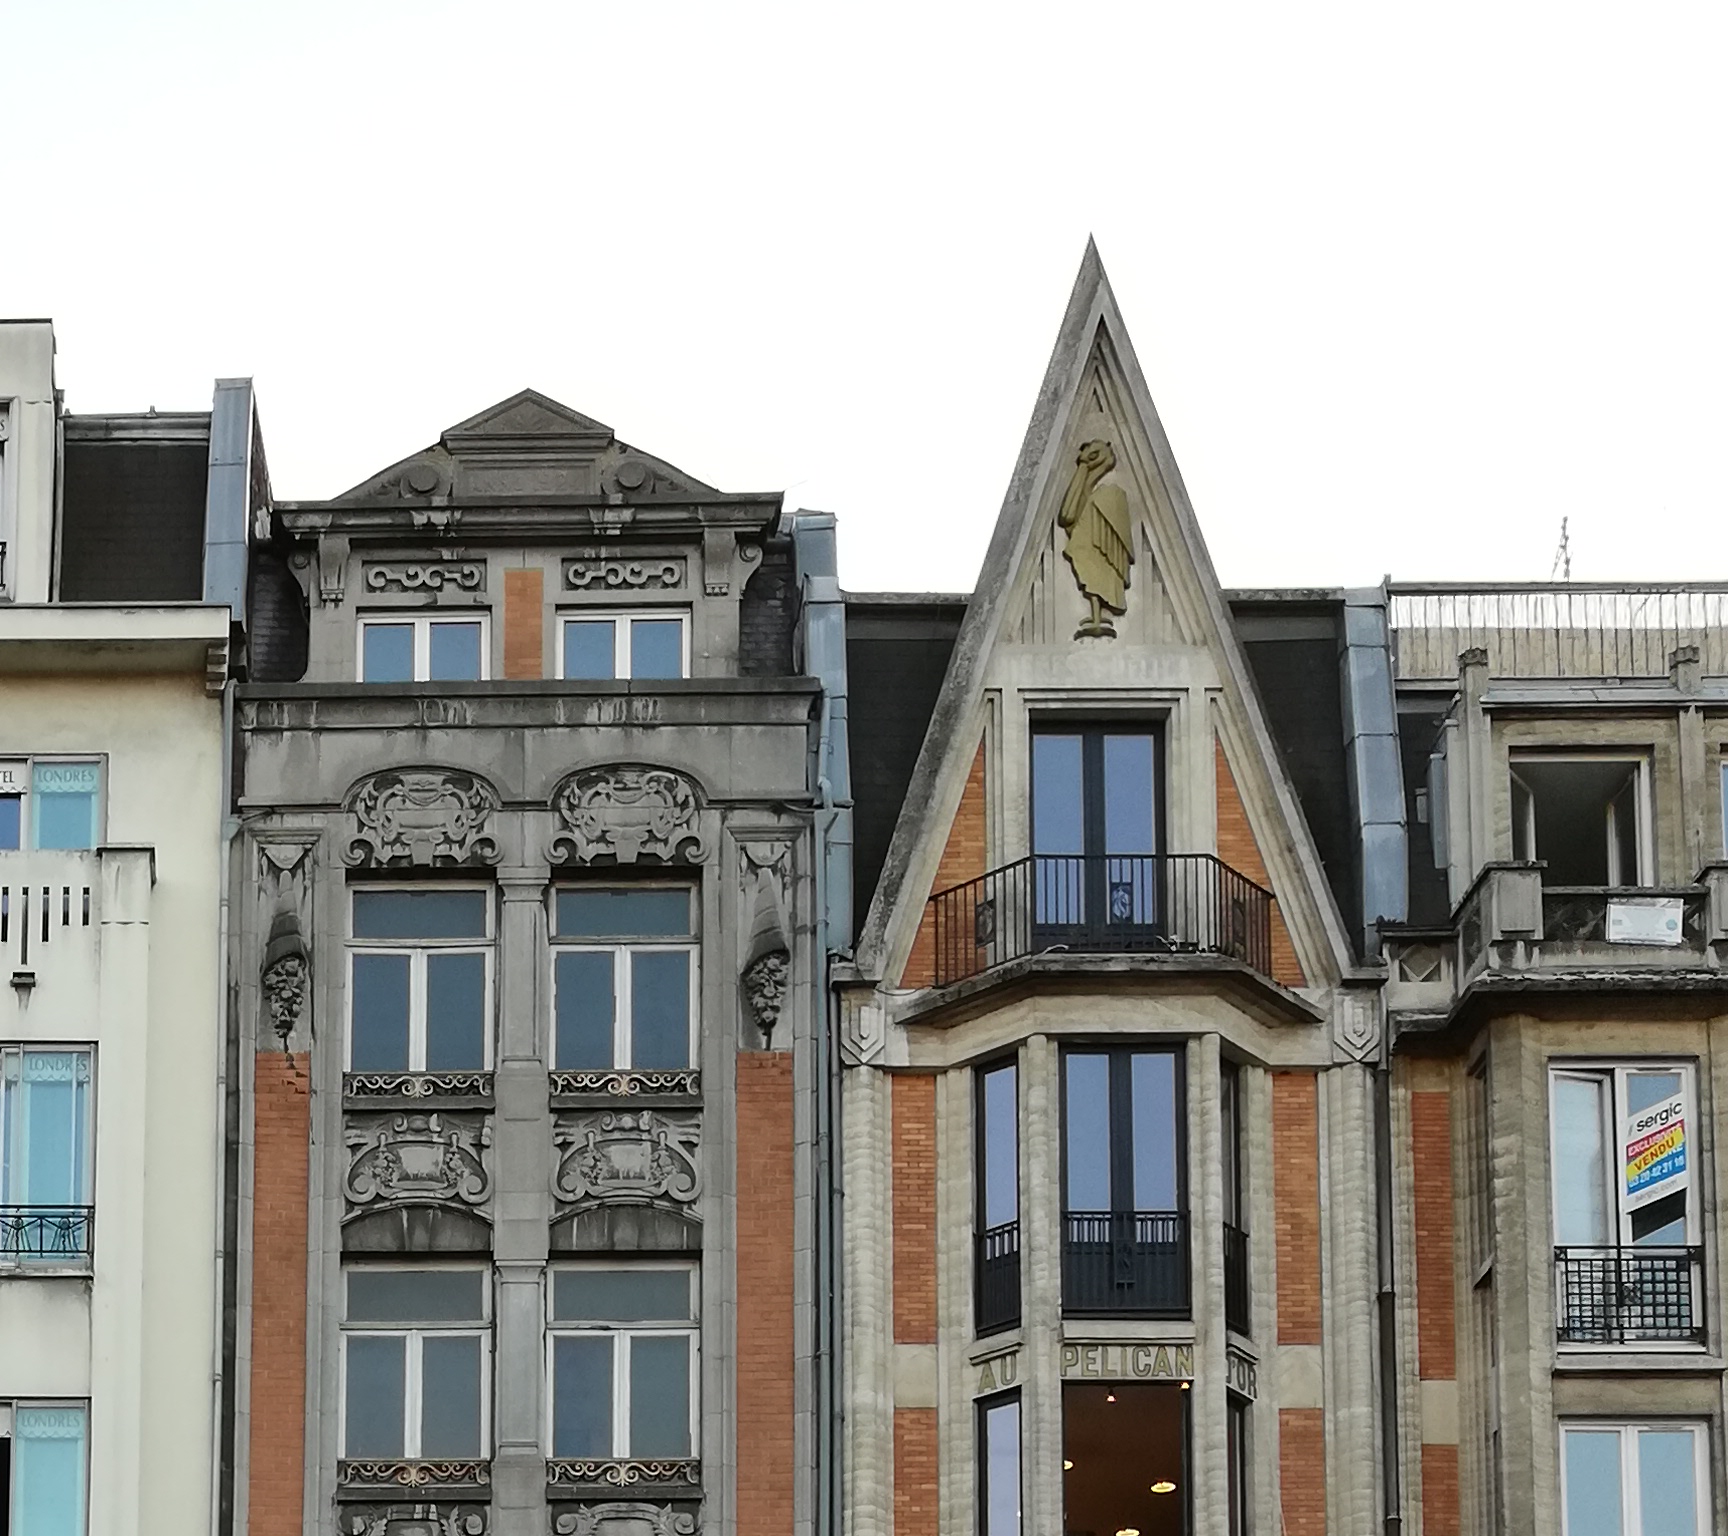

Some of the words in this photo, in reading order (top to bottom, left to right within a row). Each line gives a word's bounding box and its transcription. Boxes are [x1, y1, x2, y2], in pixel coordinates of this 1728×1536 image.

[38, 770, 94, 784] LONDRES
[1637, 1102, 1683, 1132] sergic
[1634, 1137, 1675, 1171] VENDU
[978, 1351, 1017, 1394] AU
[1060, 1345, 1194, 1377] PELICAN
